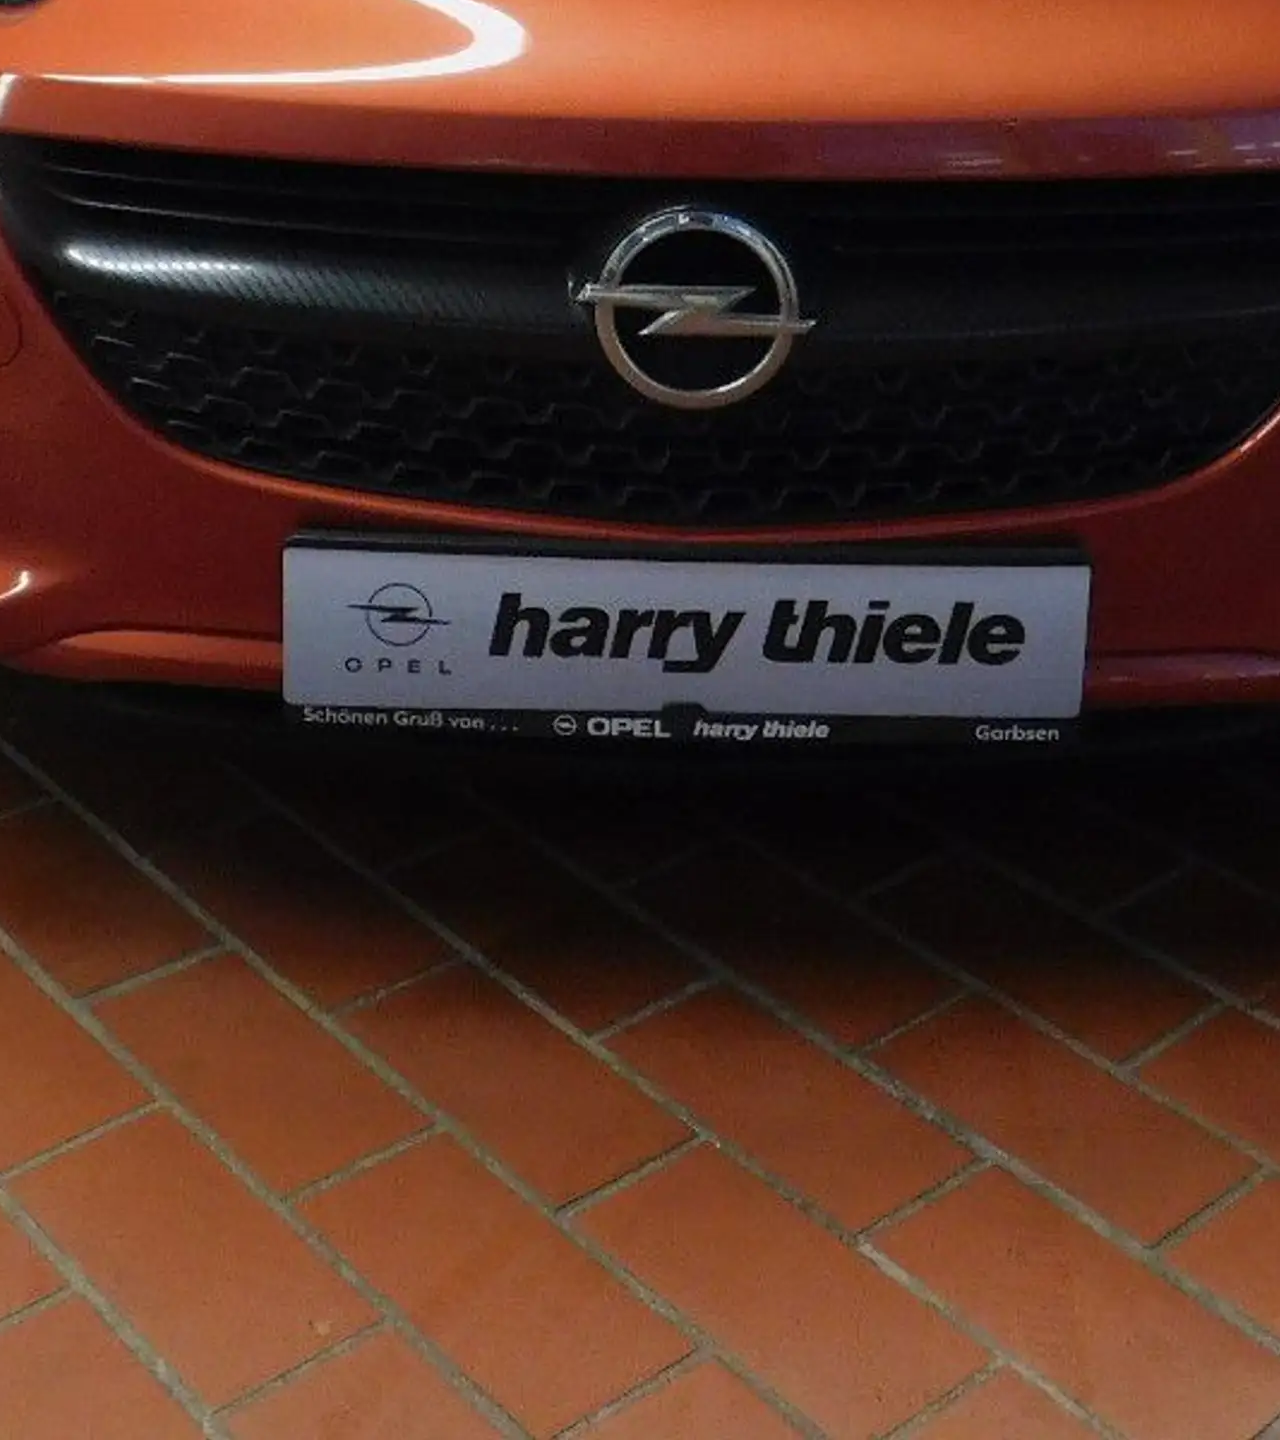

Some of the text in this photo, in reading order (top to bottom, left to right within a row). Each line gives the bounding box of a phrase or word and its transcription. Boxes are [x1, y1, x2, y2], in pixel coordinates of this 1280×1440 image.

[488, 592, 1026, 674] harry thiele
[344, 656, 452, 676] OPEL
[303, 706, 388, 726] Schönen
[393, 710, 444, 728] Gruß
[586, 717, 672, 738] OPEL
[693, 719, 831, 741] harry thiele
[974, 724, 1061, 741] Garbsen
